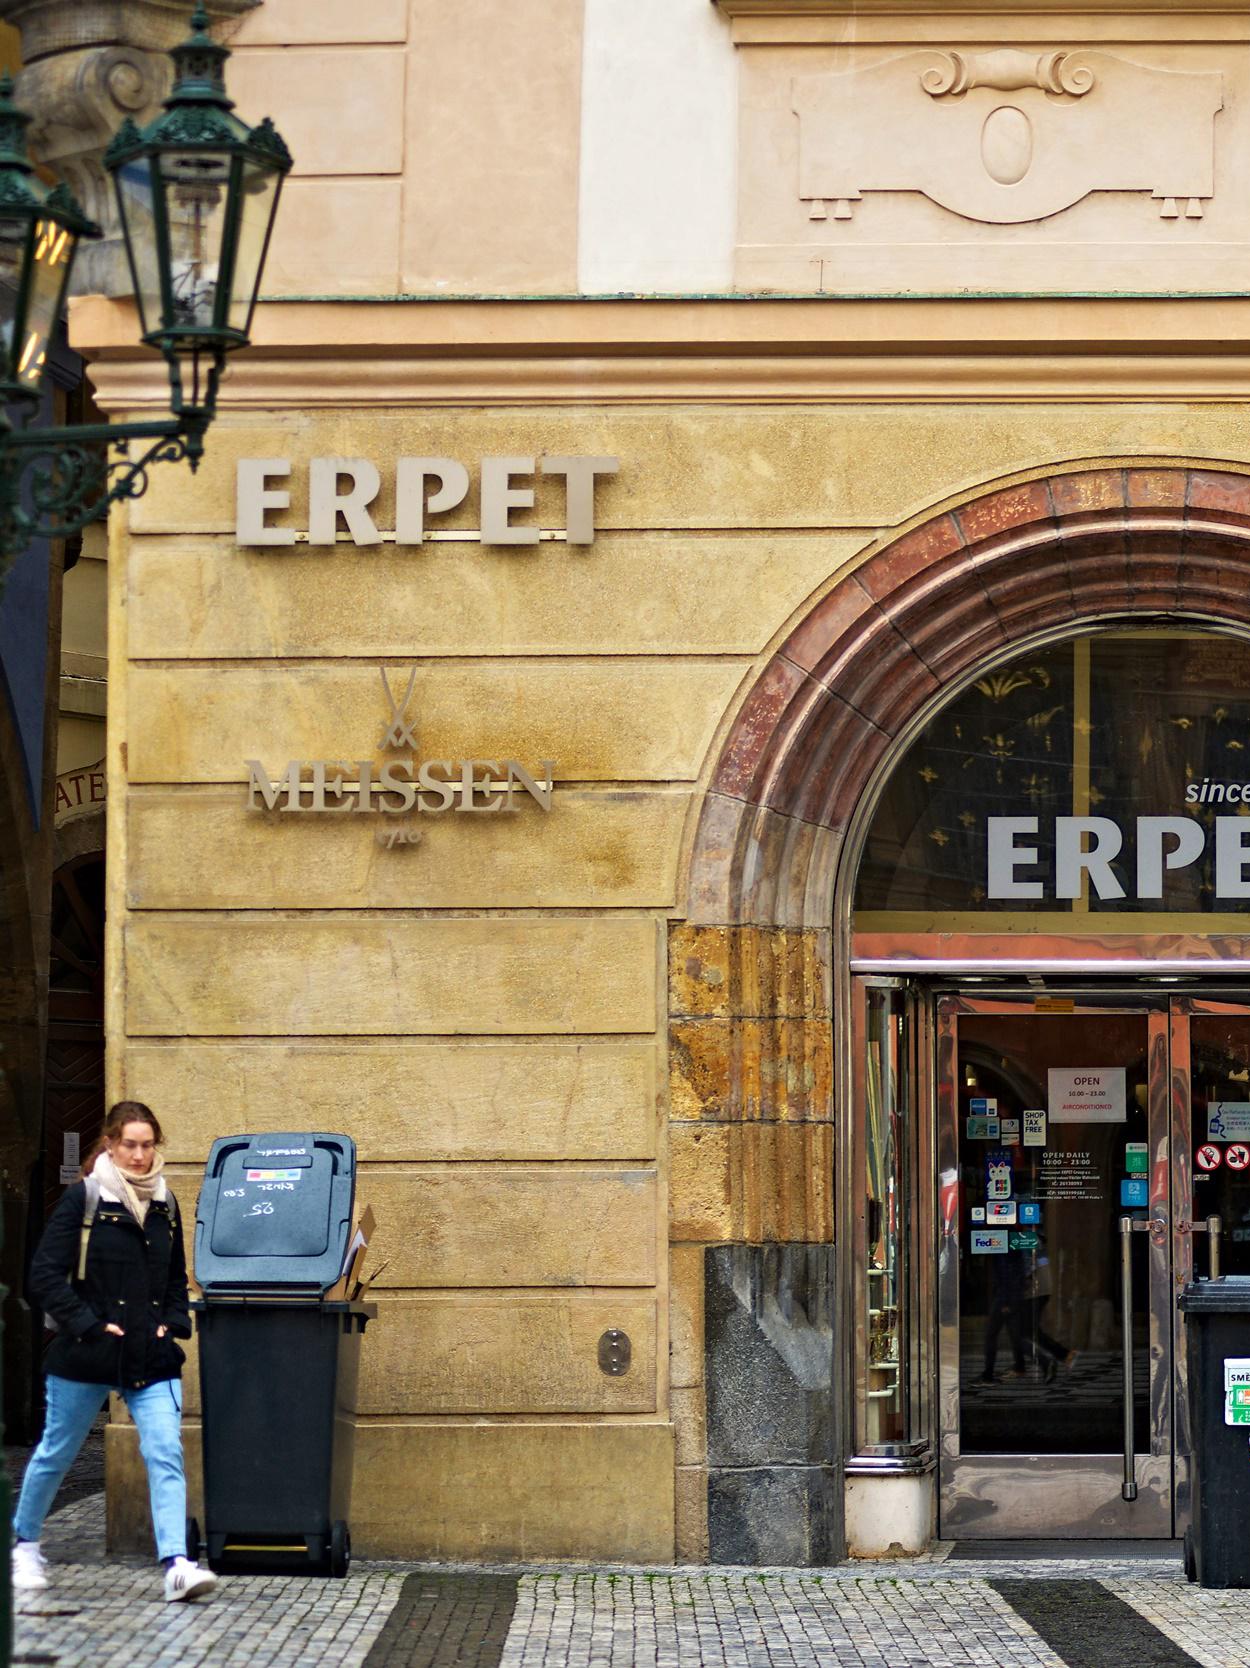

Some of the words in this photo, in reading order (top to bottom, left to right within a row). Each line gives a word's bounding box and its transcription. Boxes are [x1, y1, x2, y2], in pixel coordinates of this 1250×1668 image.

[237, 457, 619, 546] ERPET
[245, 759, 556, 813] MEISSEN
[1073, 1077, 1100, 1086] OPEN
[975, 1238, 1002, 1246] FedEx
